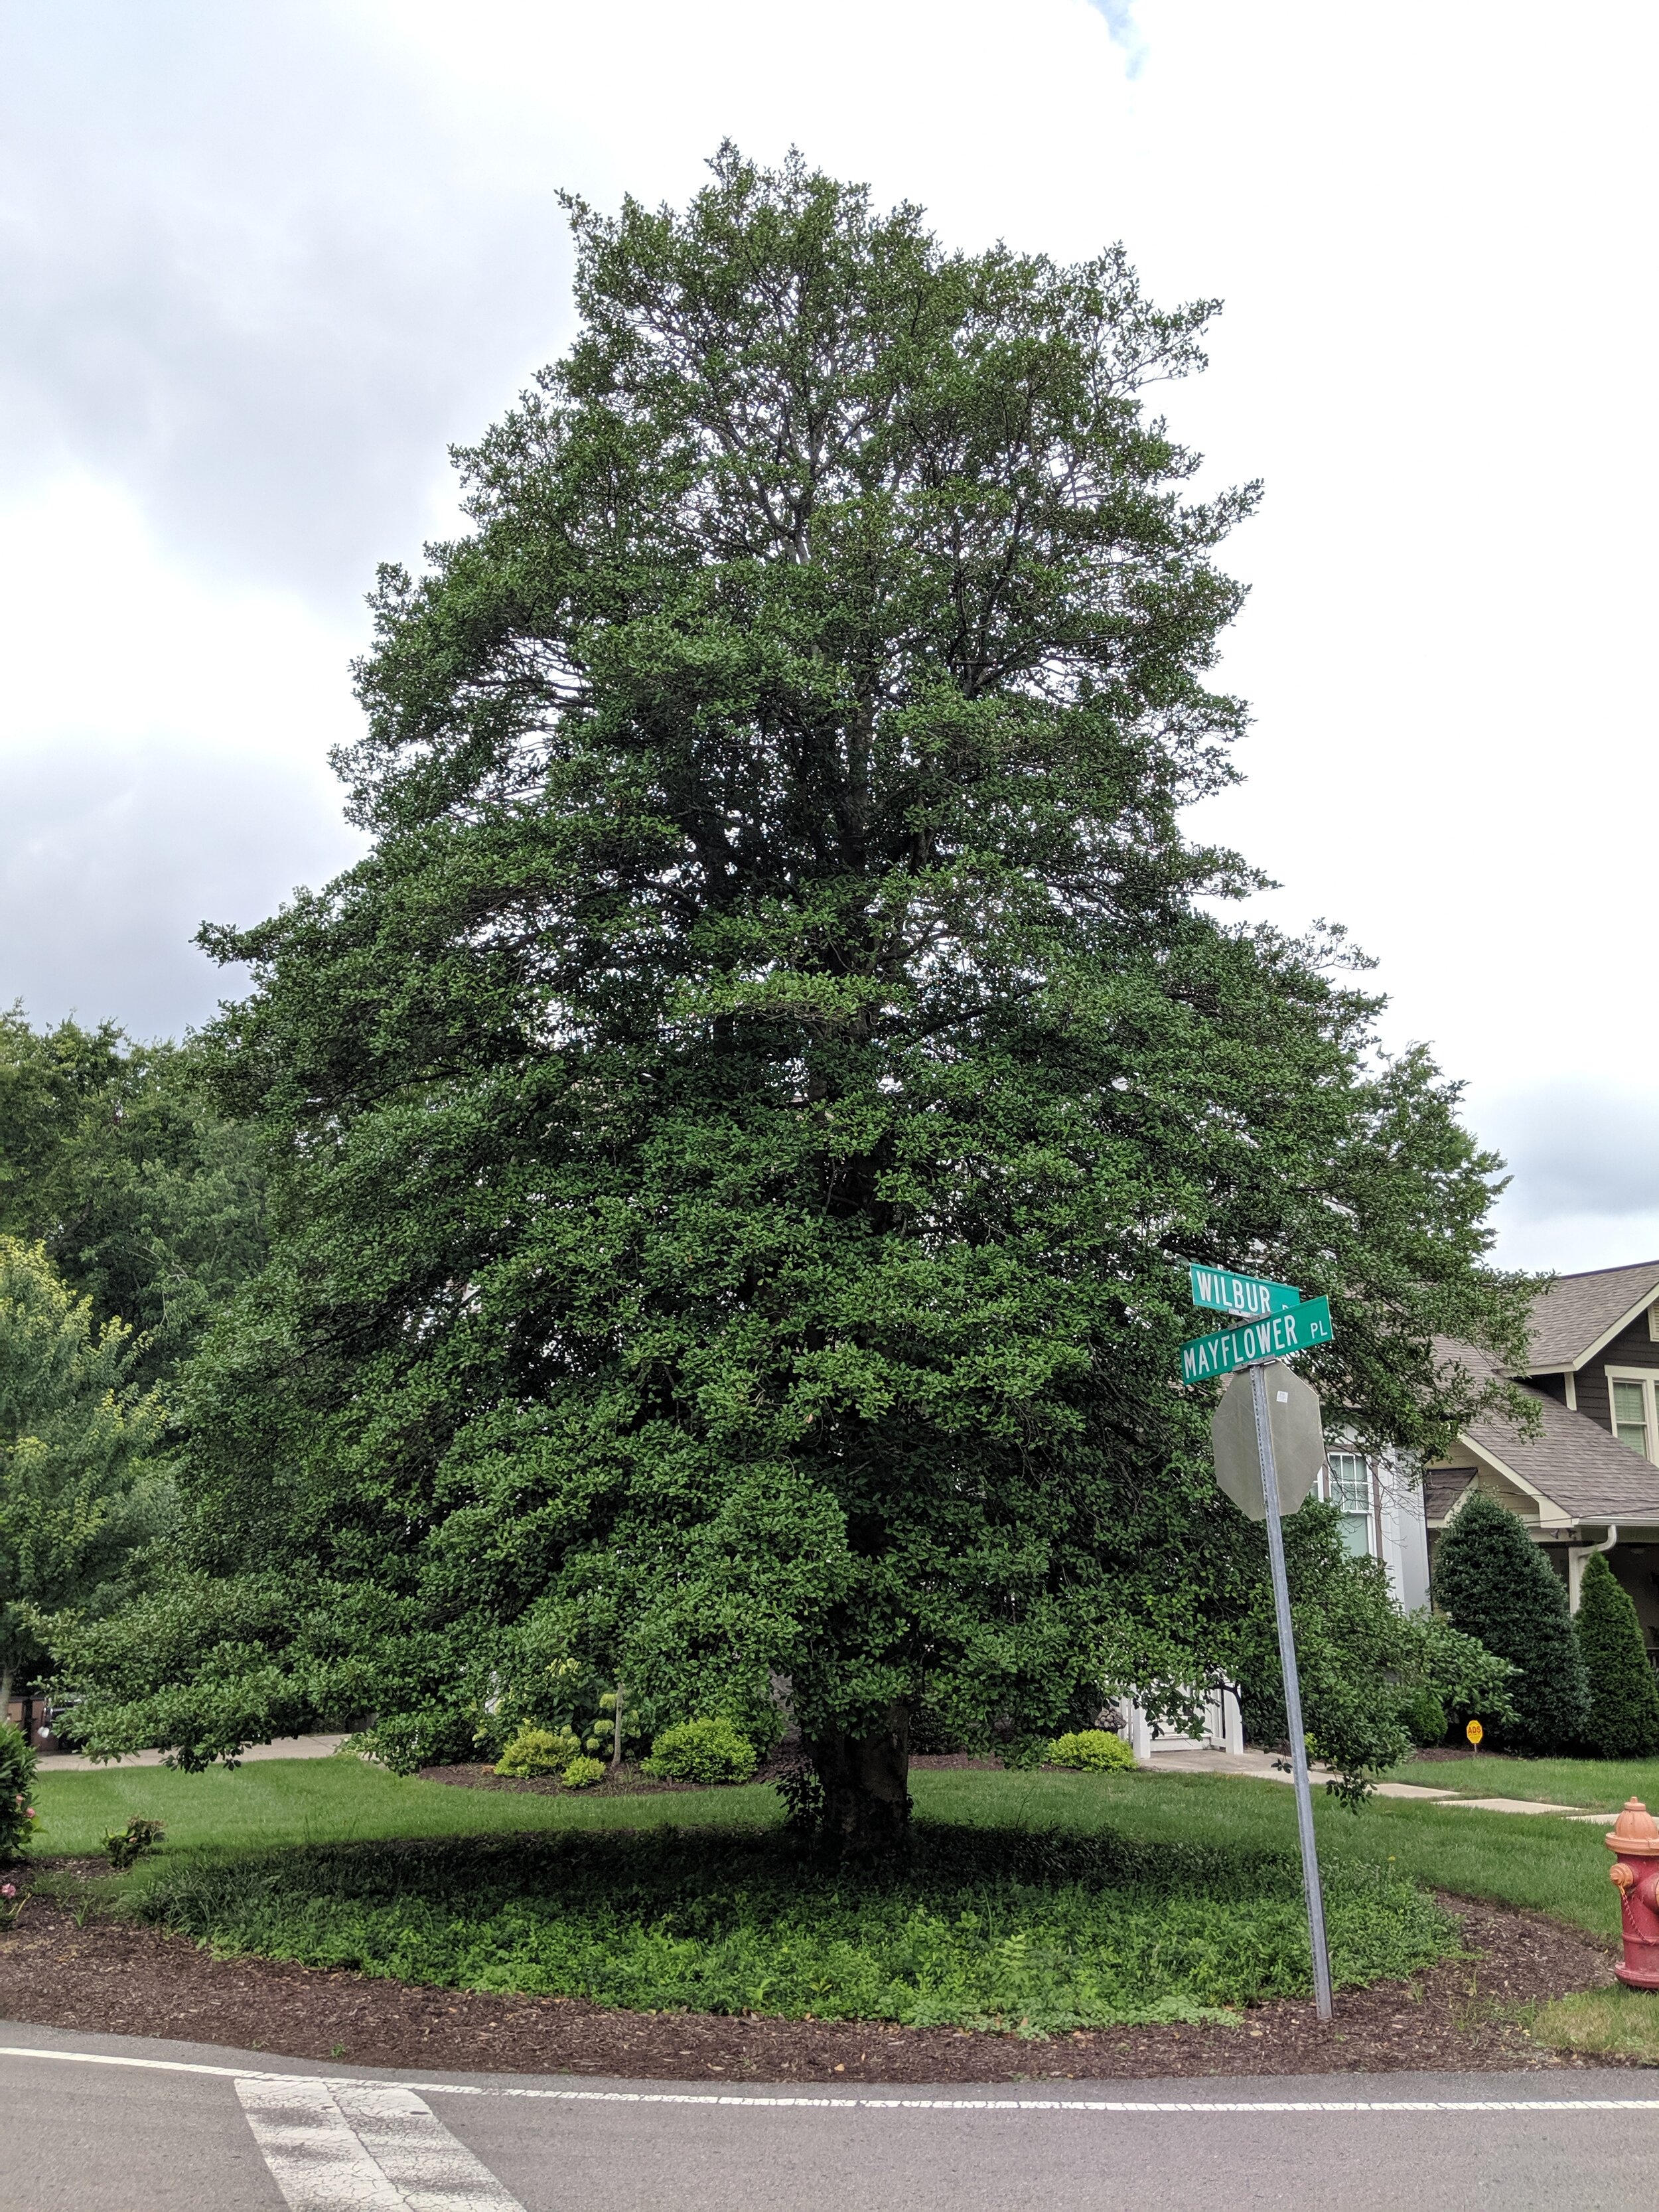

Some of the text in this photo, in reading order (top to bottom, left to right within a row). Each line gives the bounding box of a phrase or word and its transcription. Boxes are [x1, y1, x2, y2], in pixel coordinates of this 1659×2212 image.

[1196, 1270, 1271, 1313] WILBUR
[1183, 1315, 1328, 1379] MAYFLOWER PL
